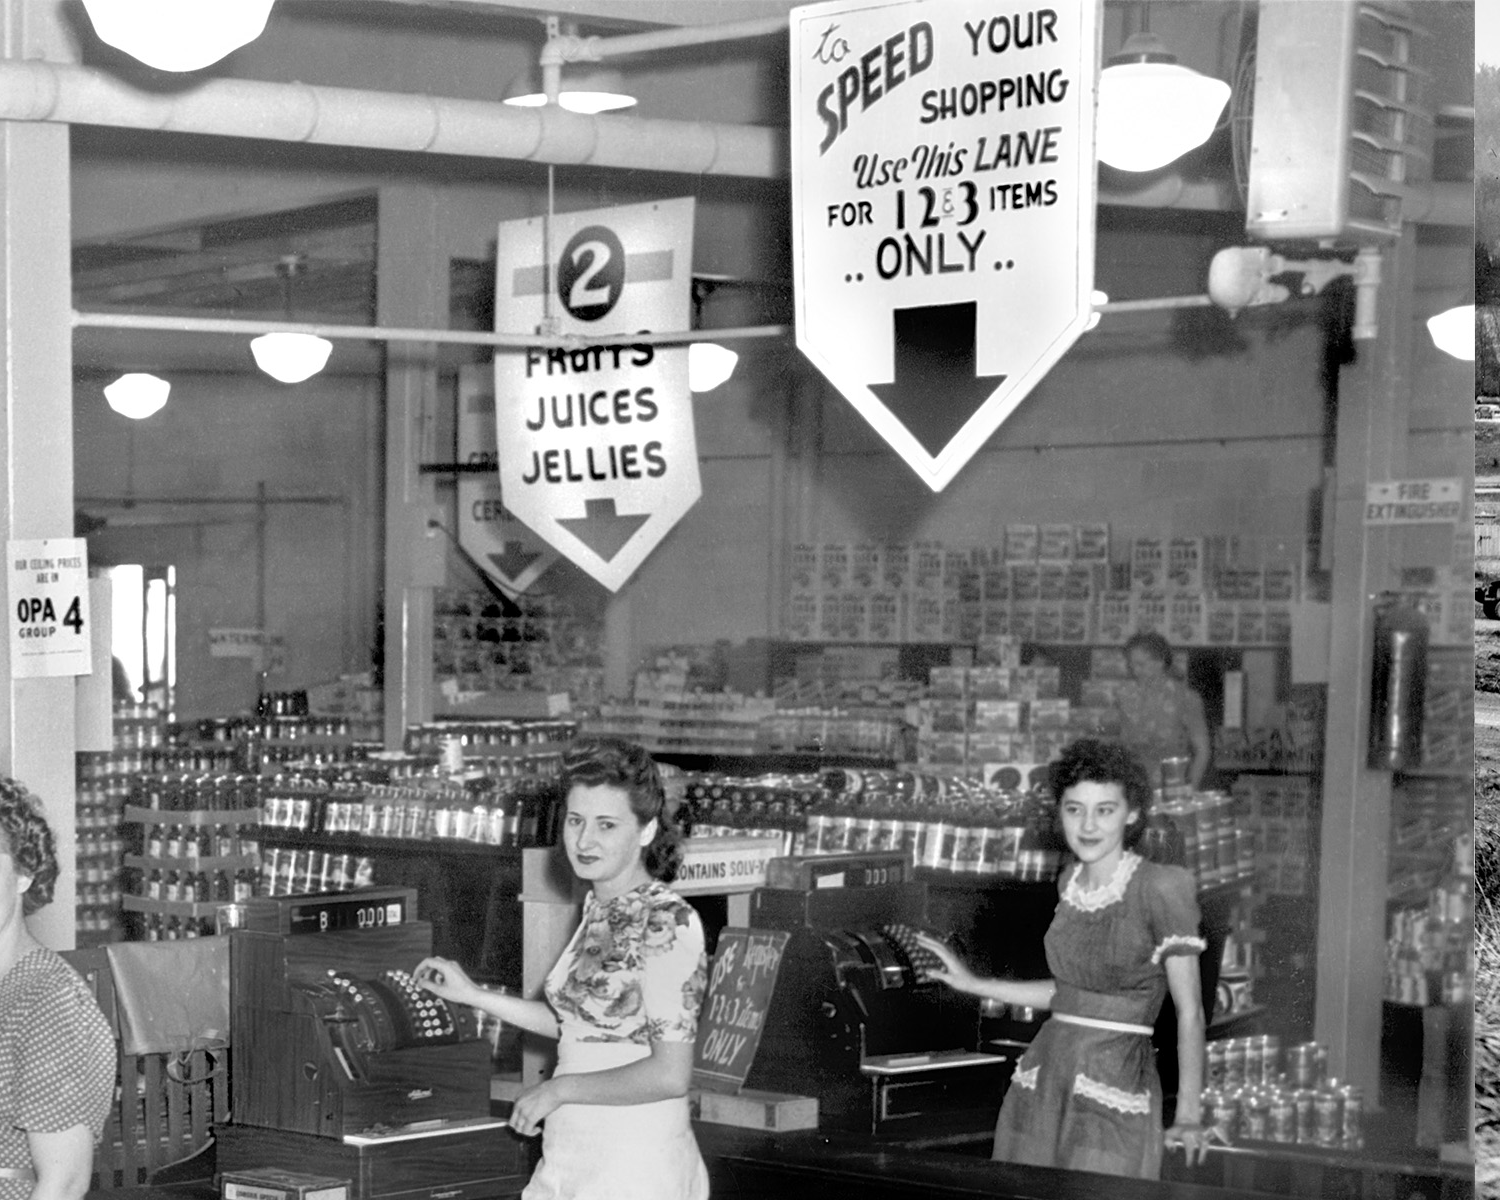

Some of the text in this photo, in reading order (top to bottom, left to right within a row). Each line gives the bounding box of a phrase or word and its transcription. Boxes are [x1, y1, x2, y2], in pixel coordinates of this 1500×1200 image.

[812, 23, 851, 64] to
[816, 9, 1058, 157] SPEED YOUR
[920, 68, 1070, 123] SHOPPING
[853, 126, 1062, 188] Use This LANE
[828, 201, 874, 228] FOR
[990, 180, 1058, 211] ITEMS
[569, 240, 611, 308] 2
[525, 330, 654, 378] FRUITS
[526, 387, 659, 431] JUICES
[522, 441, 667, 484] JELLIES
[1398, 483, 1430, 500] FIRE
[14, 557, 82, 571] OUR CEILING PRICES
[36, 572, 59, 583] ARE IN
[17, 595, 85, 635] OPA 4
[18, 626, 56, 639] GROUP
[729, 859, 766, 877] SOLV-X
[319, 911, 328, 929] B
[702, 1028, 747, 1067] ONLY
